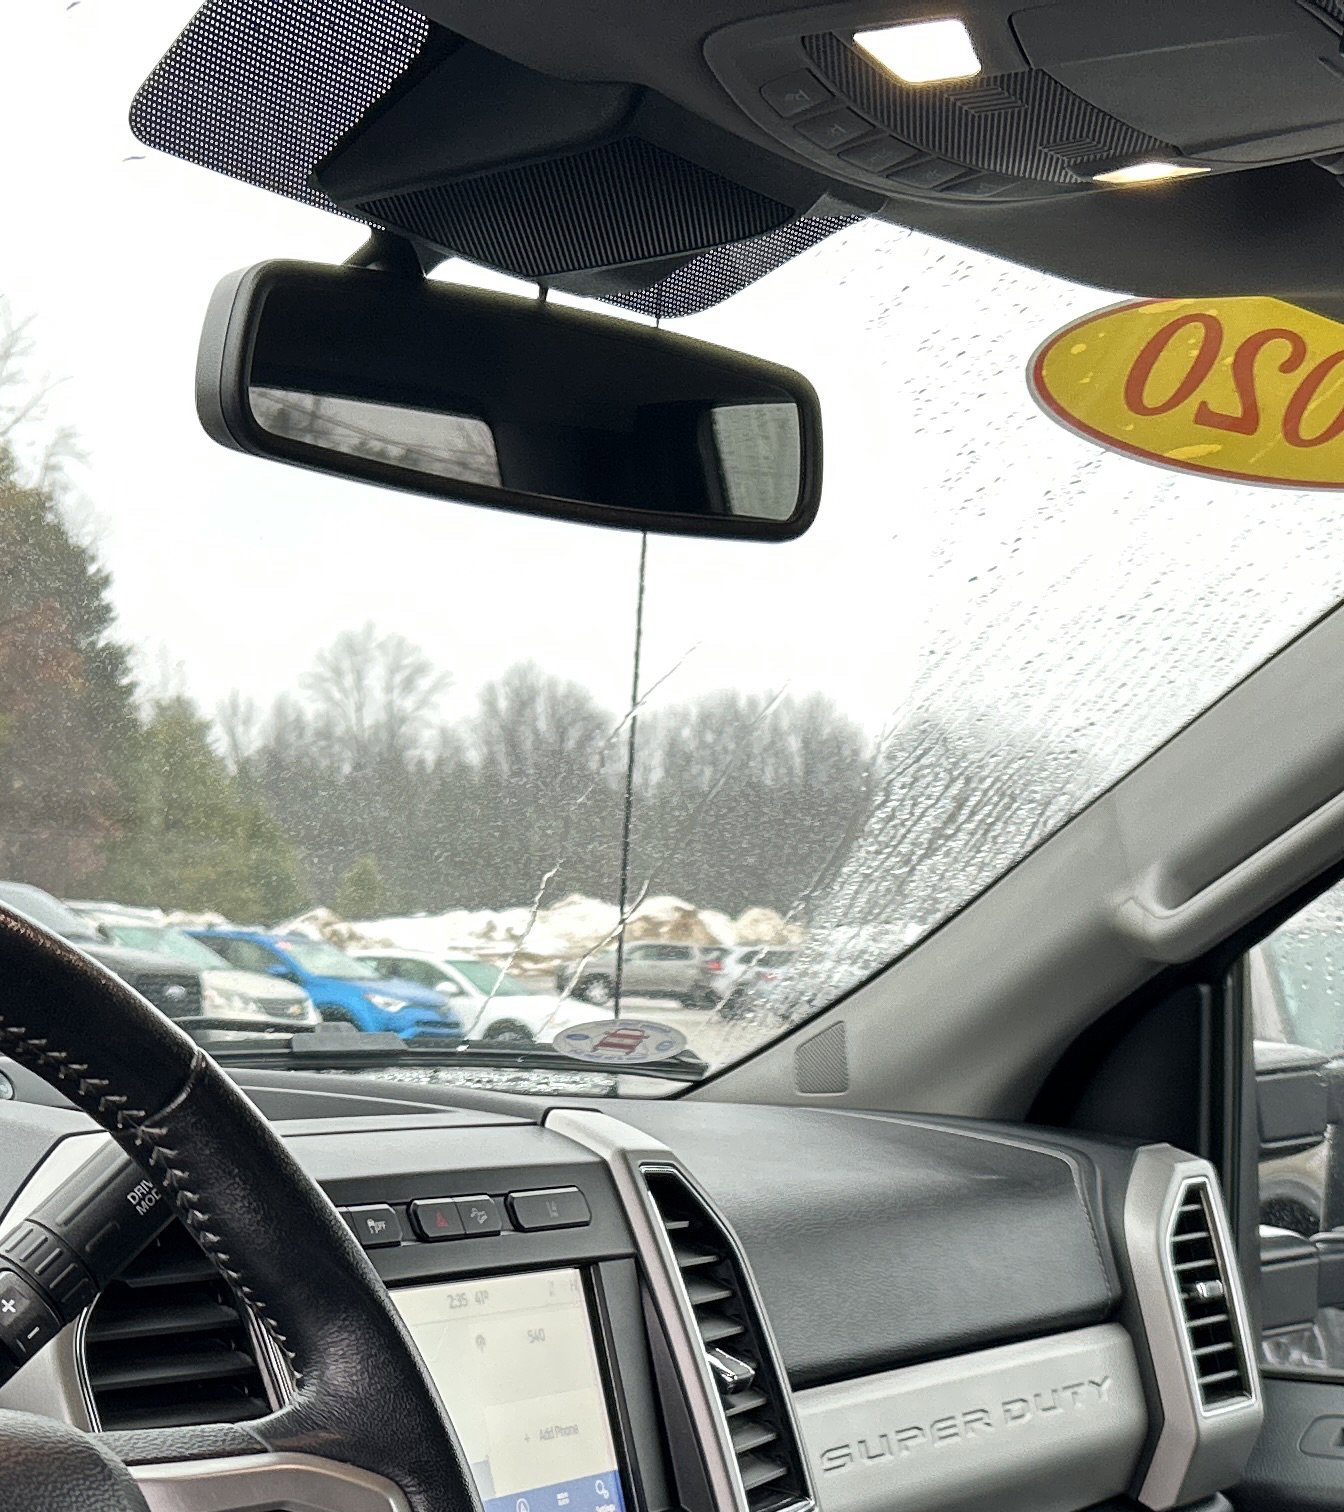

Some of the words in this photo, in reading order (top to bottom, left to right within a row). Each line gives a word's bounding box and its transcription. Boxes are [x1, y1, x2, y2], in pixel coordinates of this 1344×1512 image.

[126, 1179, 154, 1206] DRIV
[135, 1187, 162, 1216] MOD
[819, 1408, 994, 1475] SUPER
[1001, 1375, 1111, 1425] DUTY
